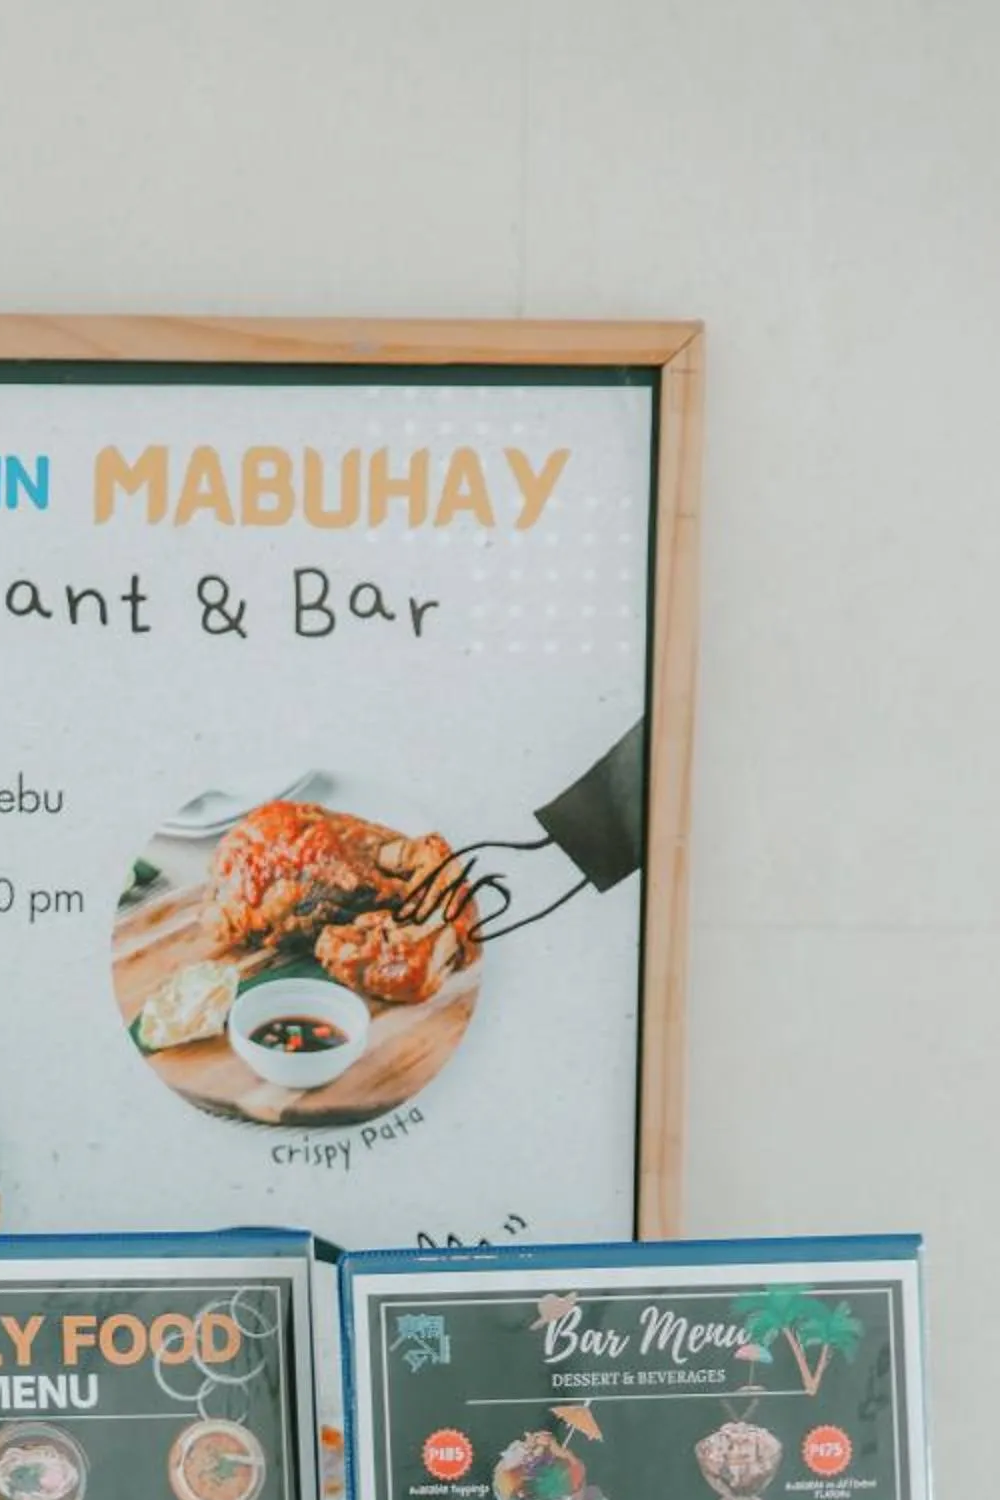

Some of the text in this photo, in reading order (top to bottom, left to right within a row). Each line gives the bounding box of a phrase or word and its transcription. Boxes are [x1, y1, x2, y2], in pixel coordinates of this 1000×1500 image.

[94, 446, 571, 529] MABUHAY
[195, 573, 249, 640] &
[292, 565, 441, 640] Bar
[29, 890, 85, 925] pm
[271, 1136, 352, 1172] crispy
[63, 1313, 243, 1367] FOOD
[542, 1305, 752, 1365] Bar Menu
[551, 1368, 727, 1388] DESSERT & BEVERAGES
